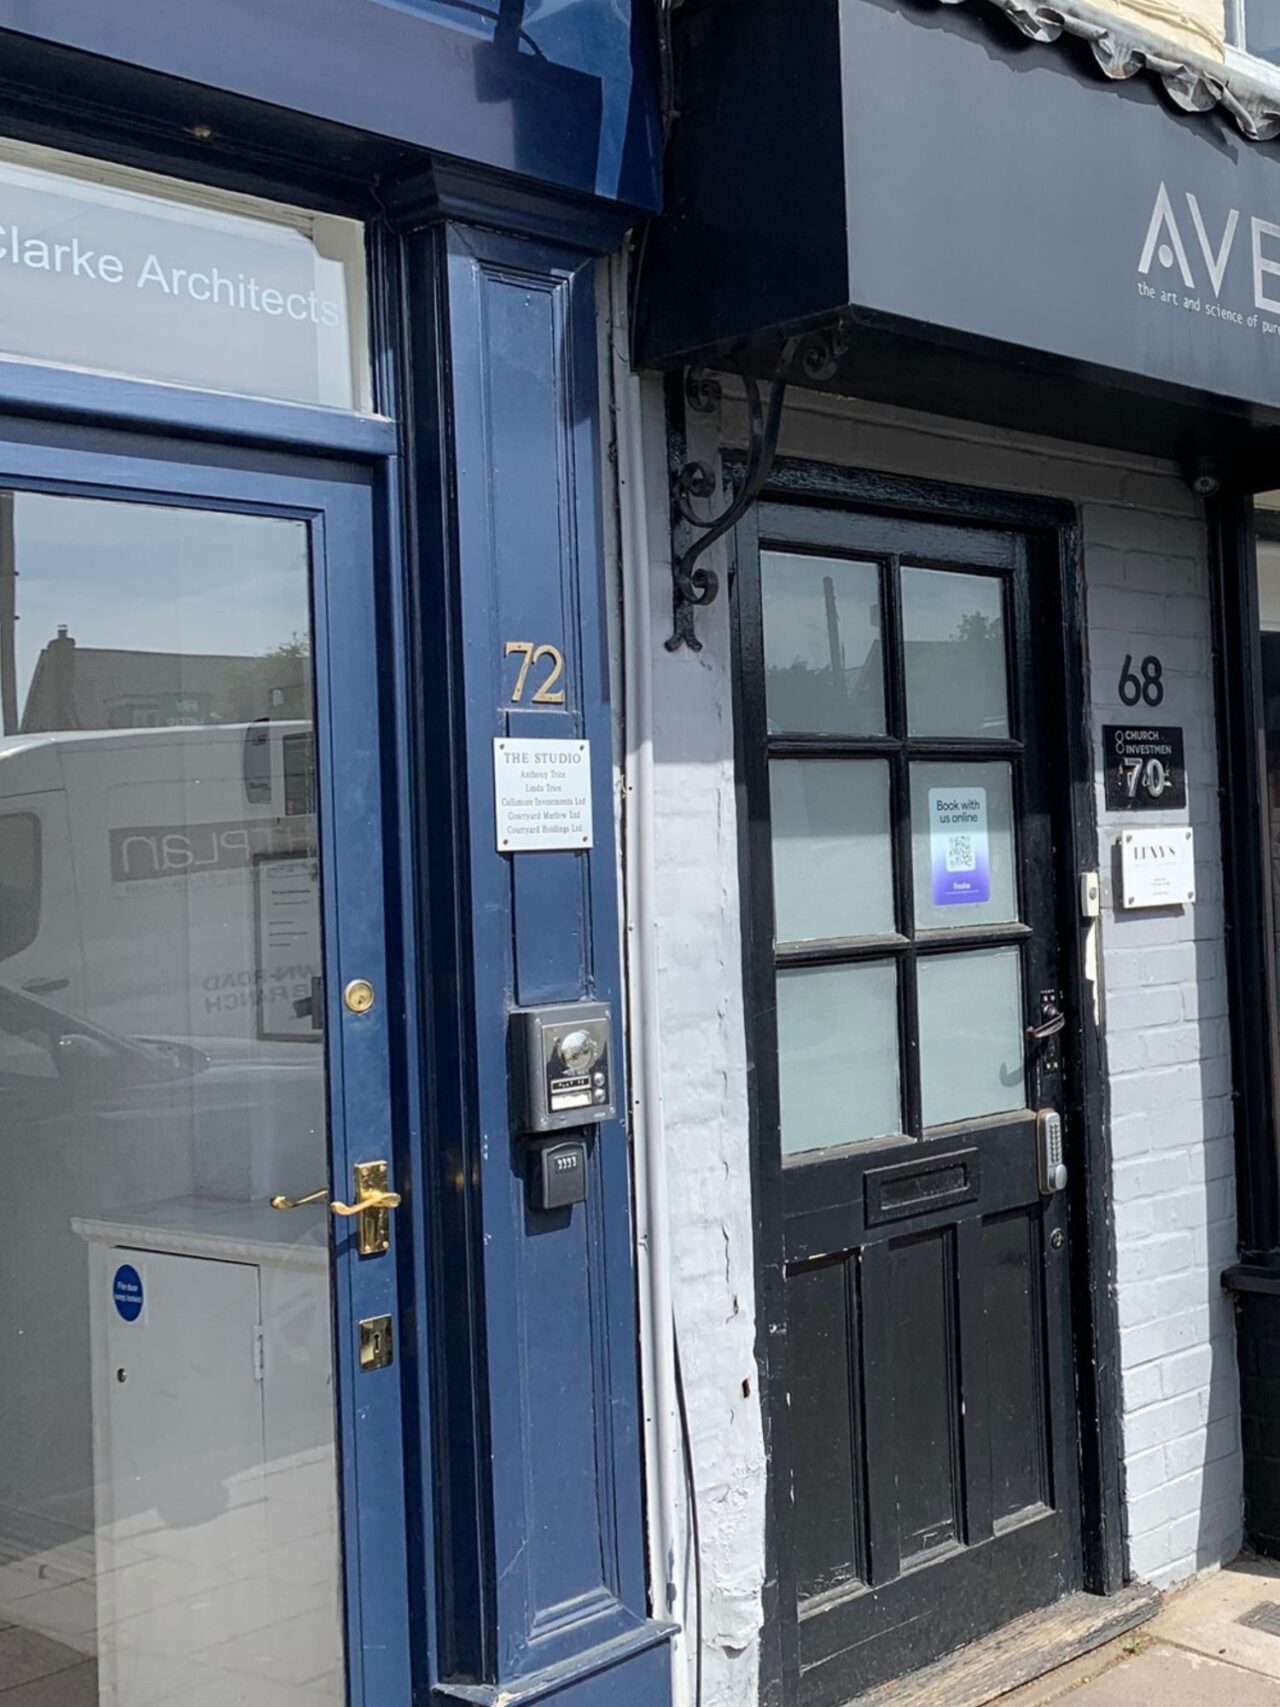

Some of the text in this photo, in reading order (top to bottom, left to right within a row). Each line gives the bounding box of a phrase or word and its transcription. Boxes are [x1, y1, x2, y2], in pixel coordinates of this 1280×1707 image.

[0, 225, 340, 327] larke Architects
[1137, 281, 1156, 300] the
[1160, 289, 1178, 306] art
[1183, 296, 1201, 312] and
[1205, 303, 1243, 325] science
[1246, 314, 1258, 328] of
[503, 641, 566, 704] 72
[1118, 654, 1164, 707] 68
[1125, 730, 1160, 740] CHURCH
[504, 752, 581, 764] THE STUDIO
[1124, 757, 1165, 797] 70
[575, 796, 586, 805] Ltd
[936, 799, 981, 811] Book with
[508, 811, 541, 821] Courtyard
[569, 811, 581, 819] Ltd
[940, 812, 979, 823] us online
[507, 825, 541, 835] Courtyard
[571, 824, 583, 832] Ltd
